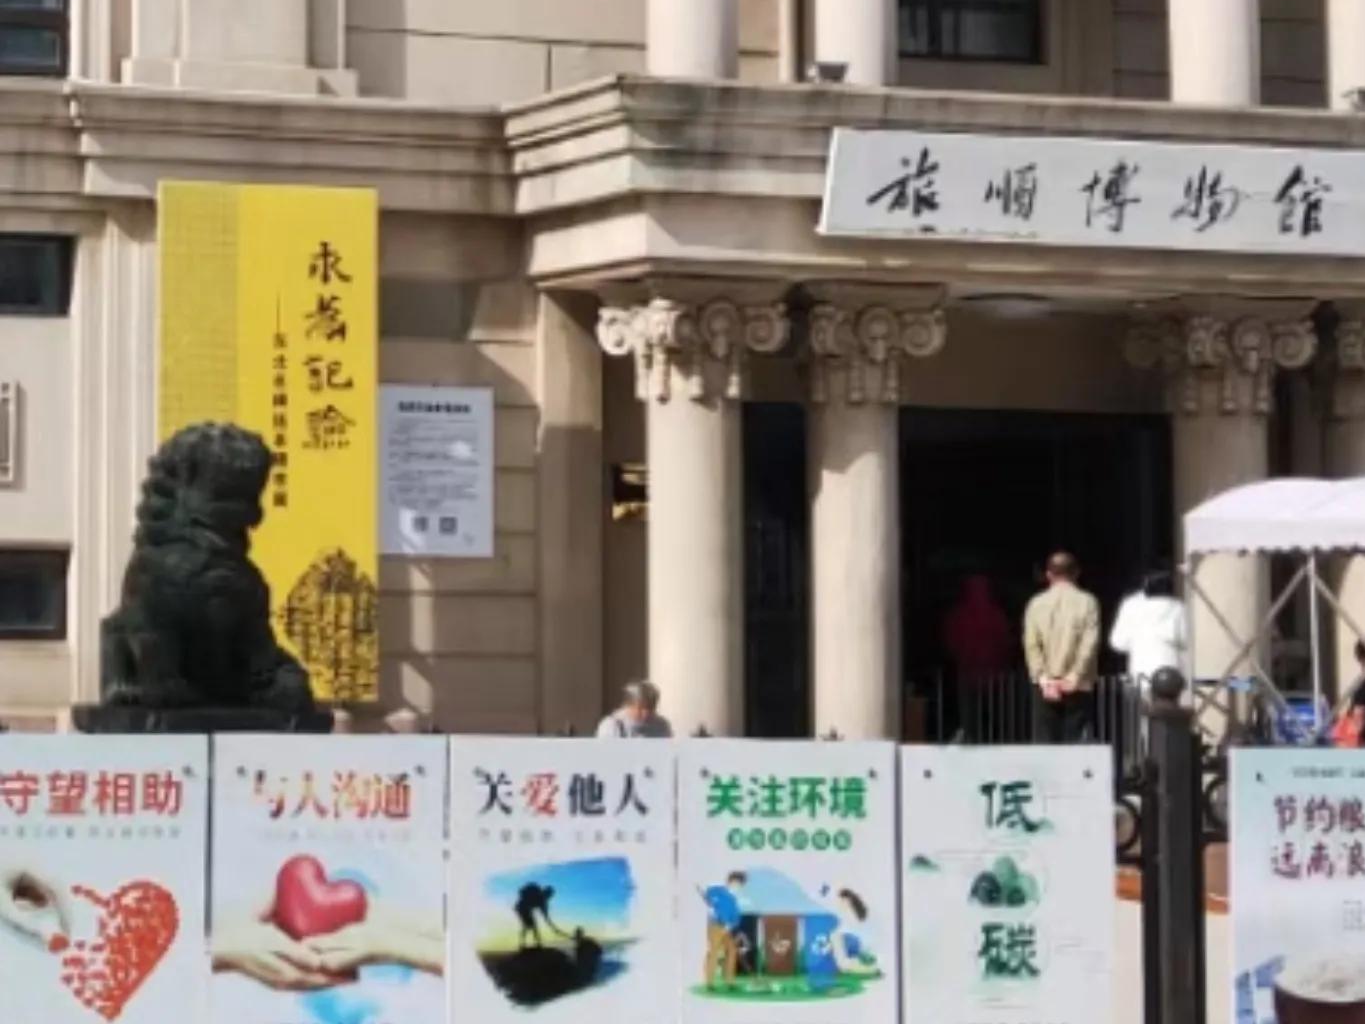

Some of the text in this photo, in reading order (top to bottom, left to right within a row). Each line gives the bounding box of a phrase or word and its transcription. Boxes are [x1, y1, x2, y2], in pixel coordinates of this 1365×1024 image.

[0, 770, 183, 816] 守望相助
[255, 769, 411, 818] 与人沟通
[478, 771, 649, 816] 关爱他人
[706, 775, 868, 819] 关注环境
